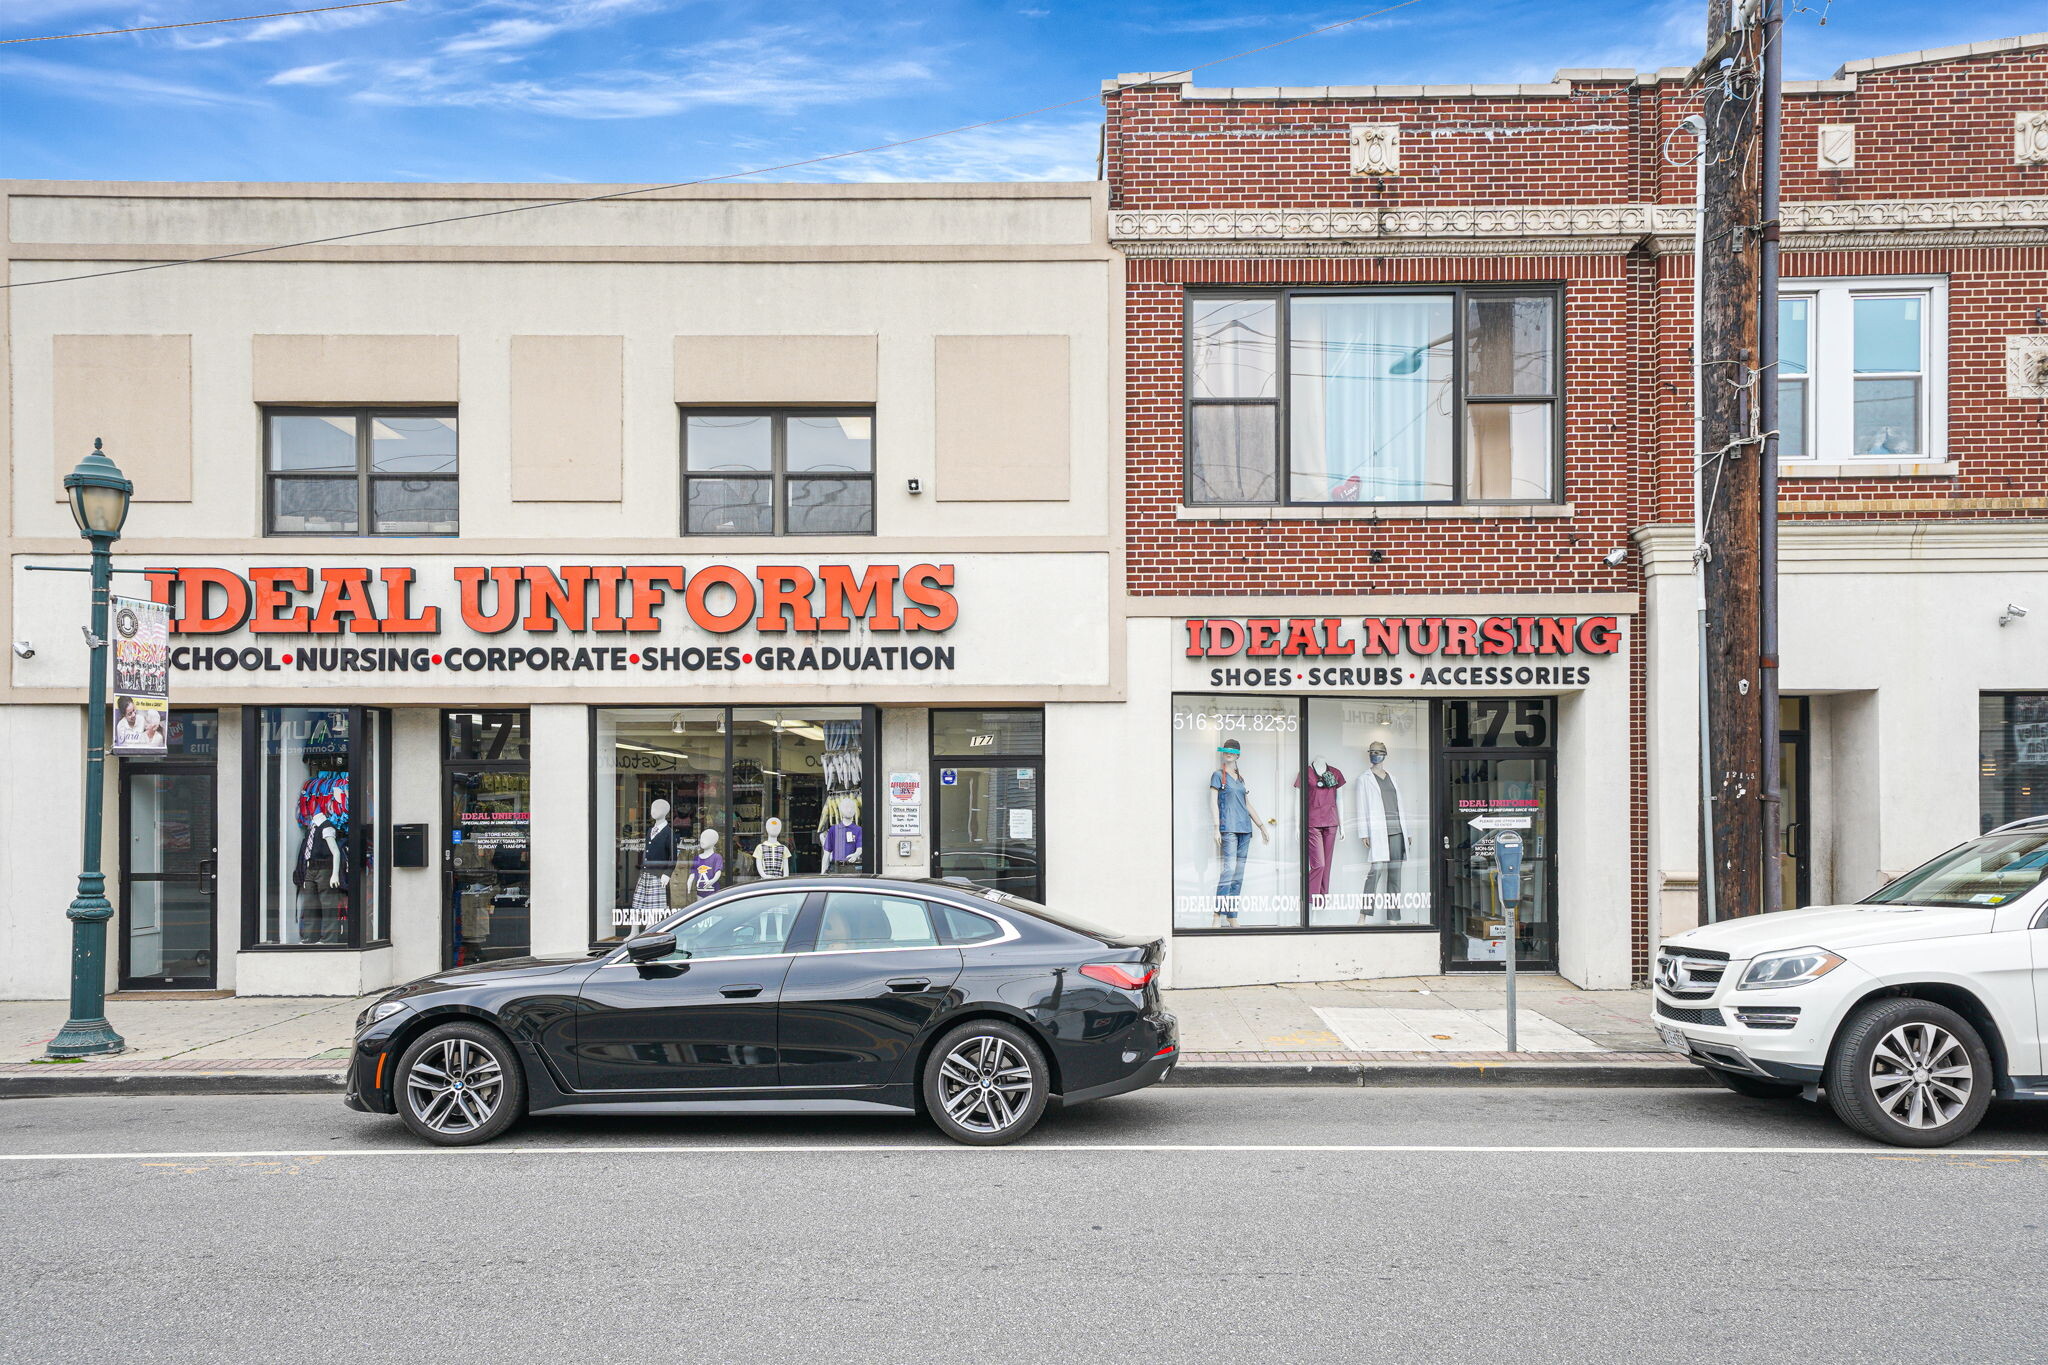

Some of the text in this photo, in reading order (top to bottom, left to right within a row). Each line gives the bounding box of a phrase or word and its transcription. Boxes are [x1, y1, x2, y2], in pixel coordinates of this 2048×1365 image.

[144, 567, 441, 634] IDEAL
[454, 563, 959, 634] UNIFORMS
[1185, 616, 1622, 657] IDEAL NURSING
[168, 646, 956, 672] CHOOL NURSING CORPORATE SHOES GRADUATION
[1210, 666, 1591, 687] SHOES SCRUBS ACCESSORIES
[1173, 713, 1298, 732] 516.354.8255
[1449, 701, 1547, 747] 175
[972, 735, 993, 746] 177
[890, 781, 920, 789] AFFORDABLE
[1459, 799, 1539, 808] IDEAL UNIFORMS
[461, 812, 490, 820] IDEAL
[1176, 895, 1301, 913] IDEALUNIFORM.COM
[1311, 892, 1432, 910] IDEALUNIFORM.COM
